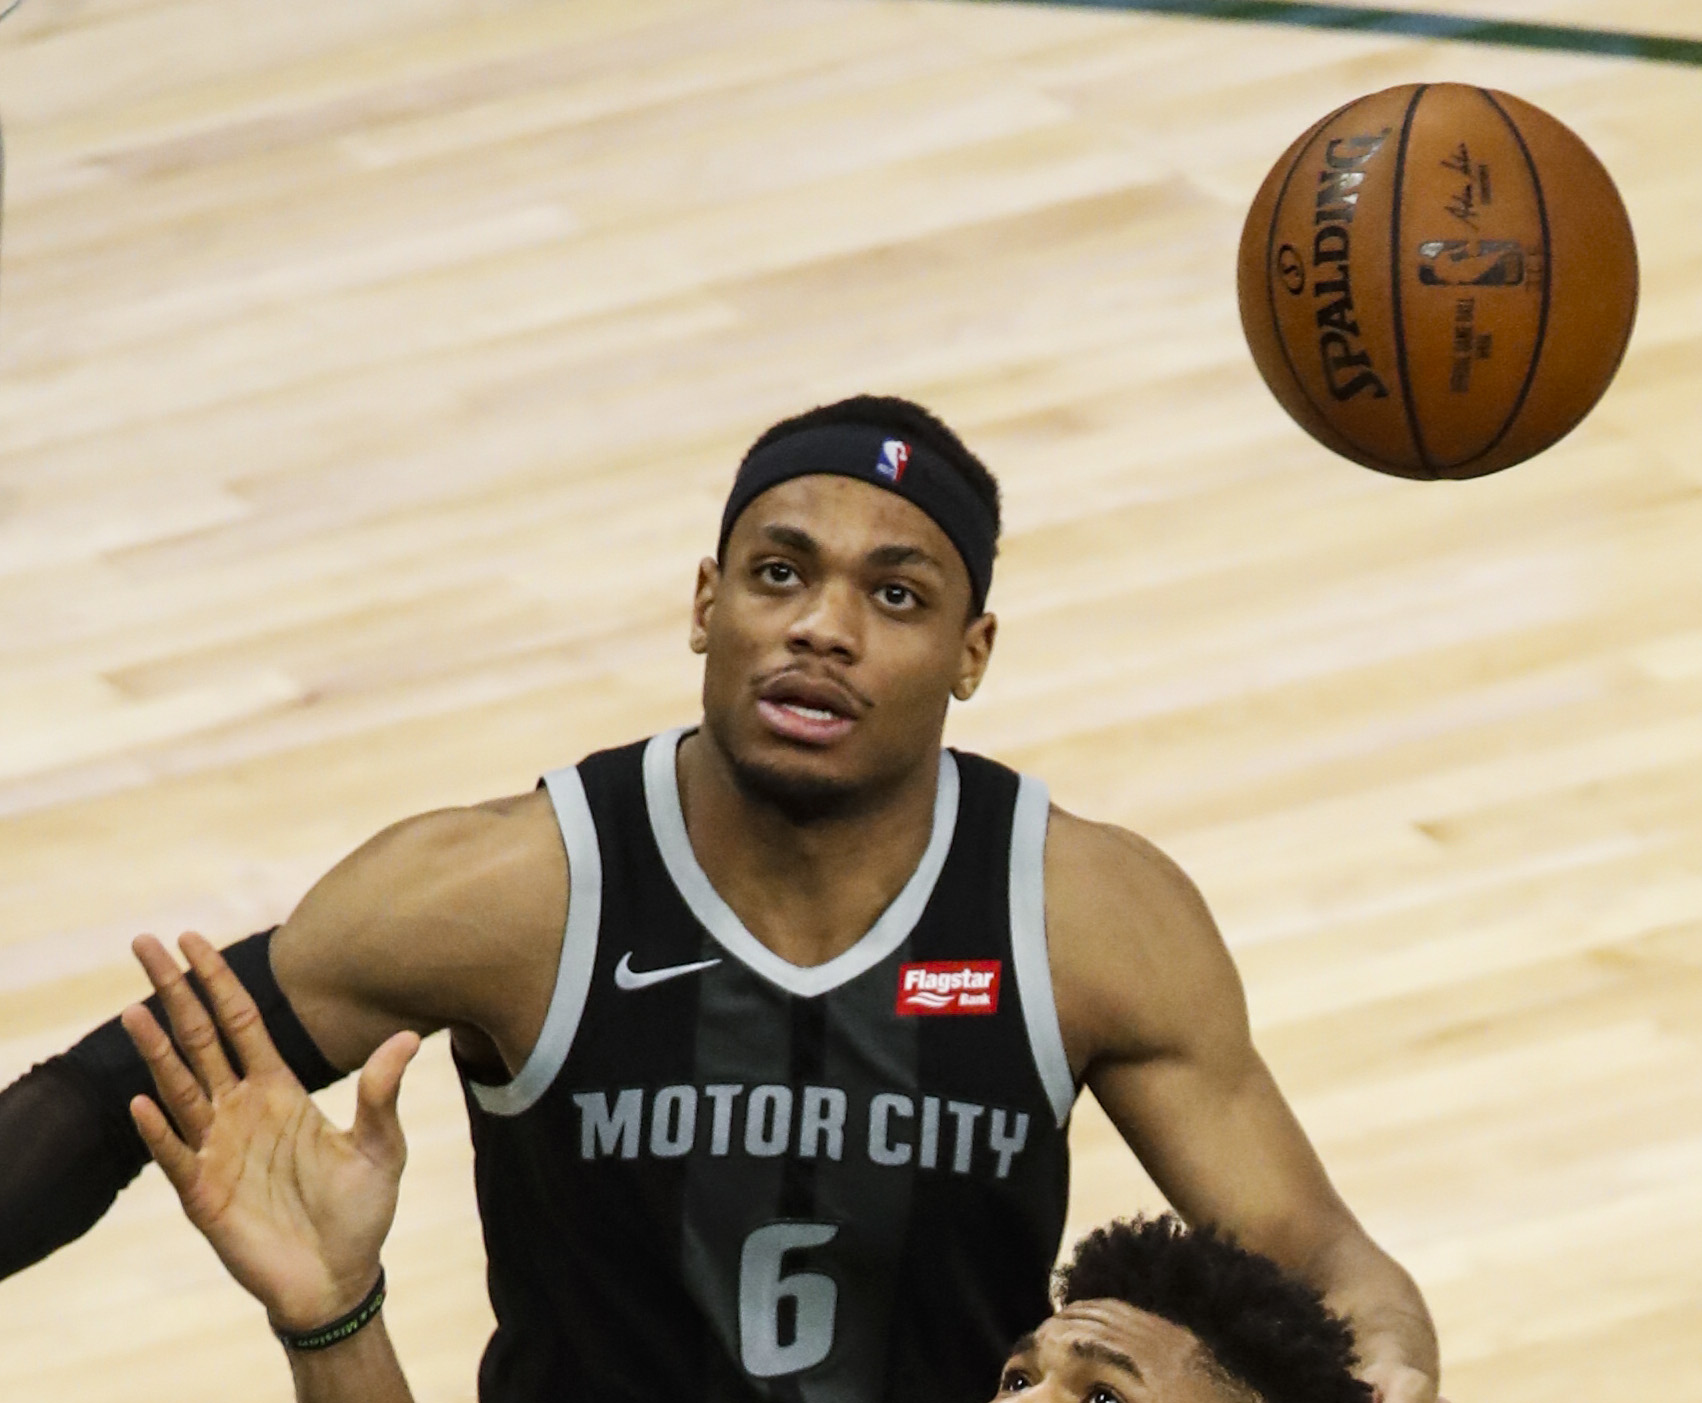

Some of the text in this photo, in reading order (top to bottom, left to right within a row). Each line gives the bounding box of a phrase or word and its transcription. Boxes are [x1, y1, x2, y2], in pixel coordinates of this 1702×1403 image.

[1313, 127, 1392, 401] SPALDING
[903, 967, 994, 993] Flagstar
[958, 992, 990, 1006] Bank
[572, 1083, 1030, 1178] MOTOR CITY
[739, 1222, 838, 1377] 6
